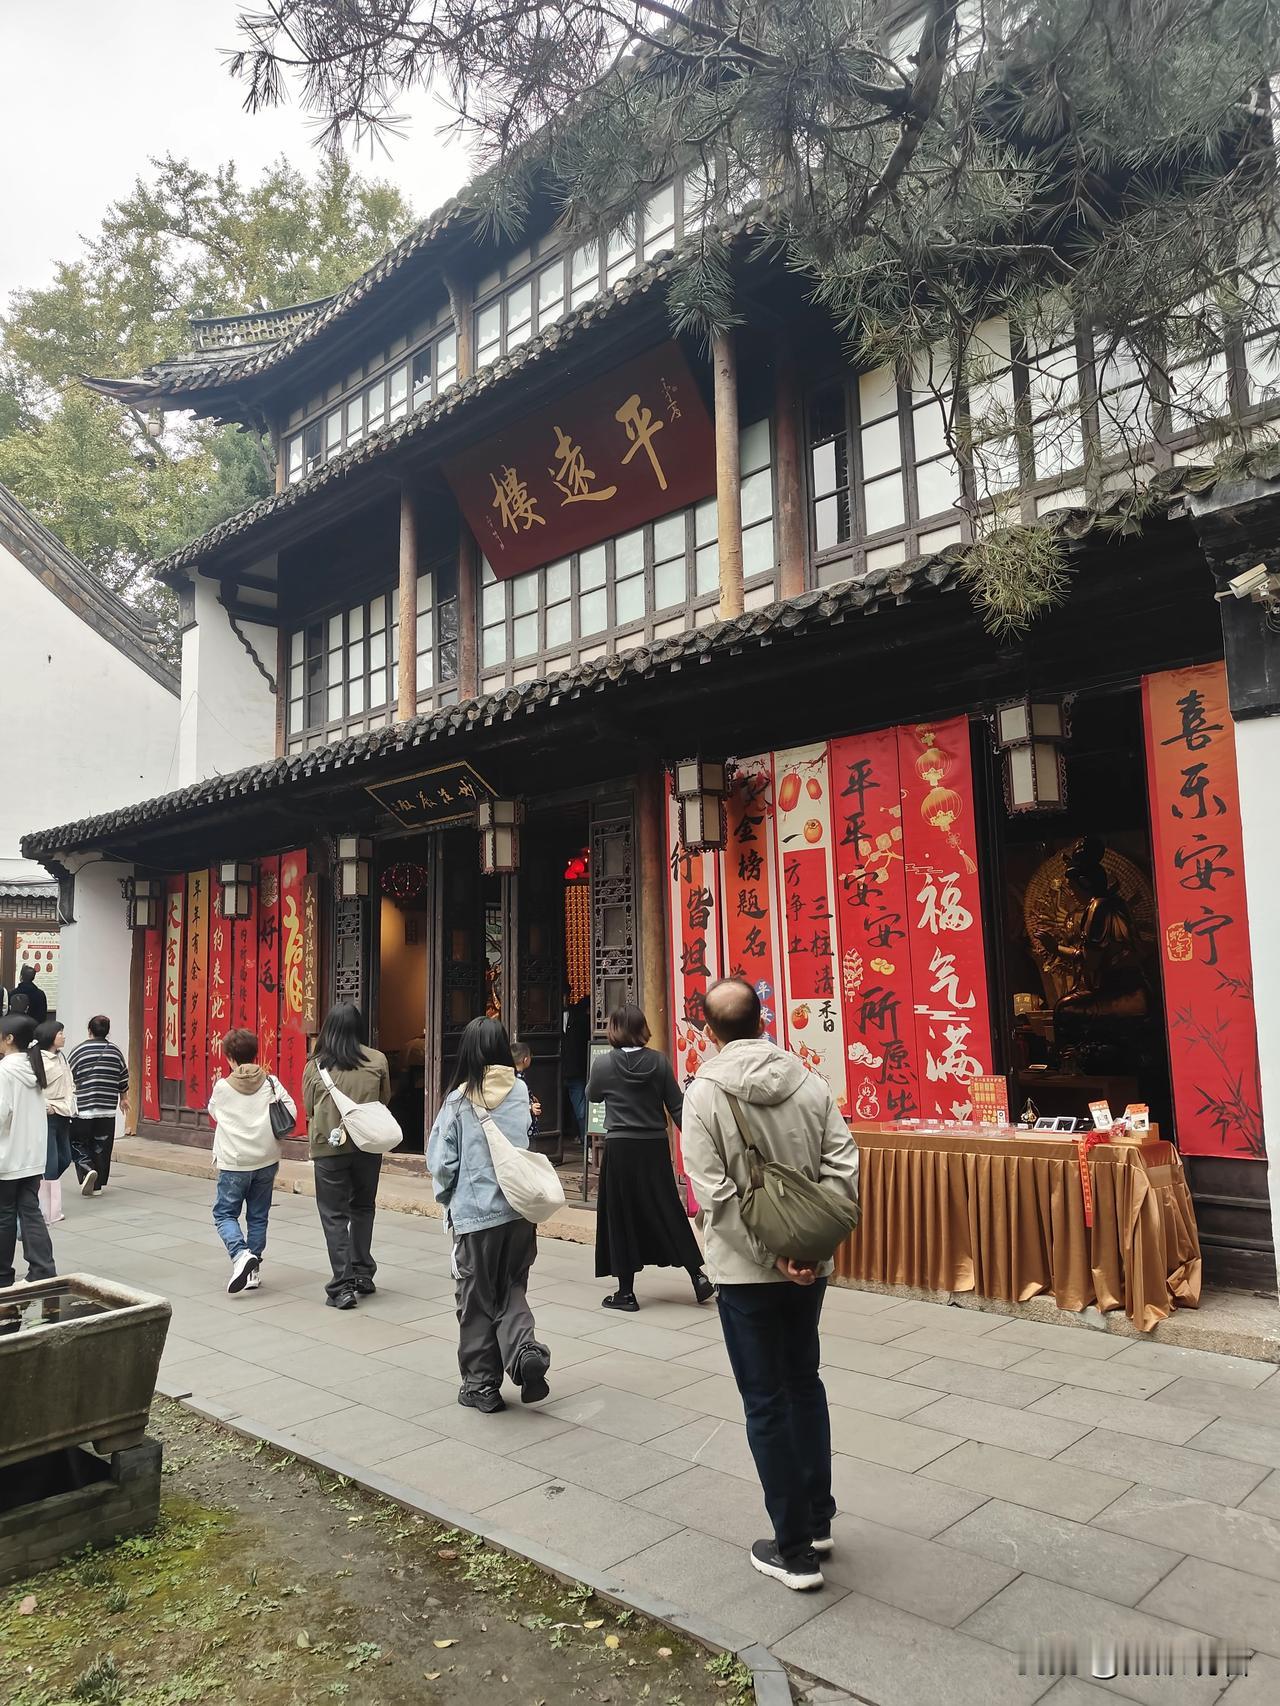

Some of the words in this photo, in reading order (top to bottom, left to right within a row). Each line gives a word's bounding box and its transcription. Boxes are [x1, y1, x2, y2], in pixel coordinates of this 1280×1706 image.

[734, 815, 768, 957] 金榜题名
[1161, 690, 1236, 966] 喜乐安宁
[165, 900, 182, 1048] 大吉大利
[189, 879, 202, 1094] 年年有余岁岁平安
[808, 896, 838, 1033] 三柱清香
